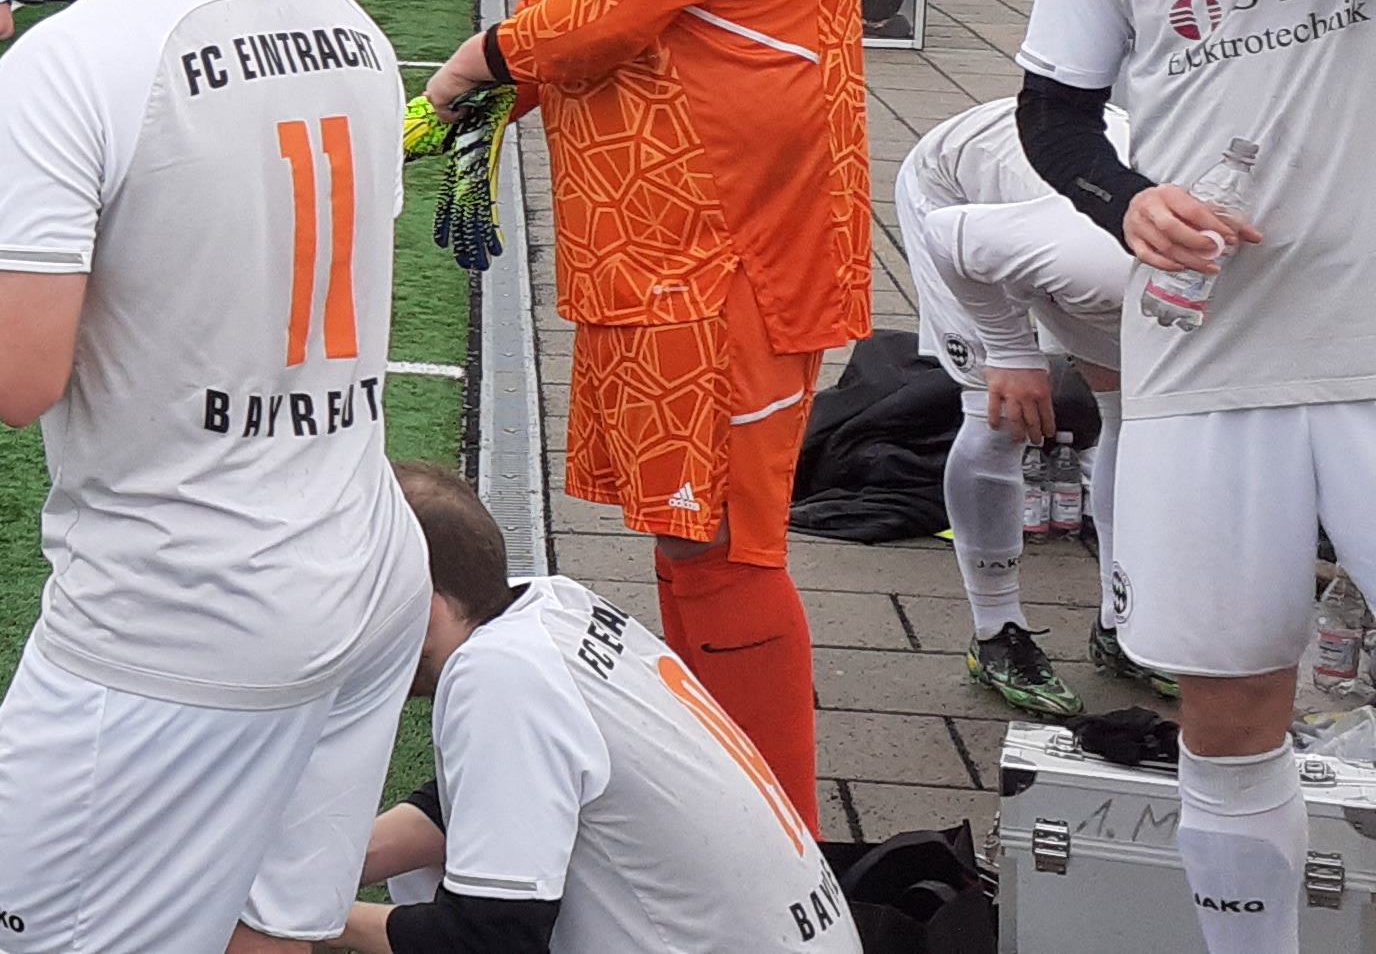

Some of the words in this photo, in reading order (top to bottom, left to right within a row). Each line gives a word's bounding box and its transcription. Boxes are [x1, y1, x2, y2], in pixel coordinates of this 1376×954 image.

[181, 45, 229, 97] FC
[232, 27, 383, 80] EINTRACHT
[277, 116, 358, 368] 11
